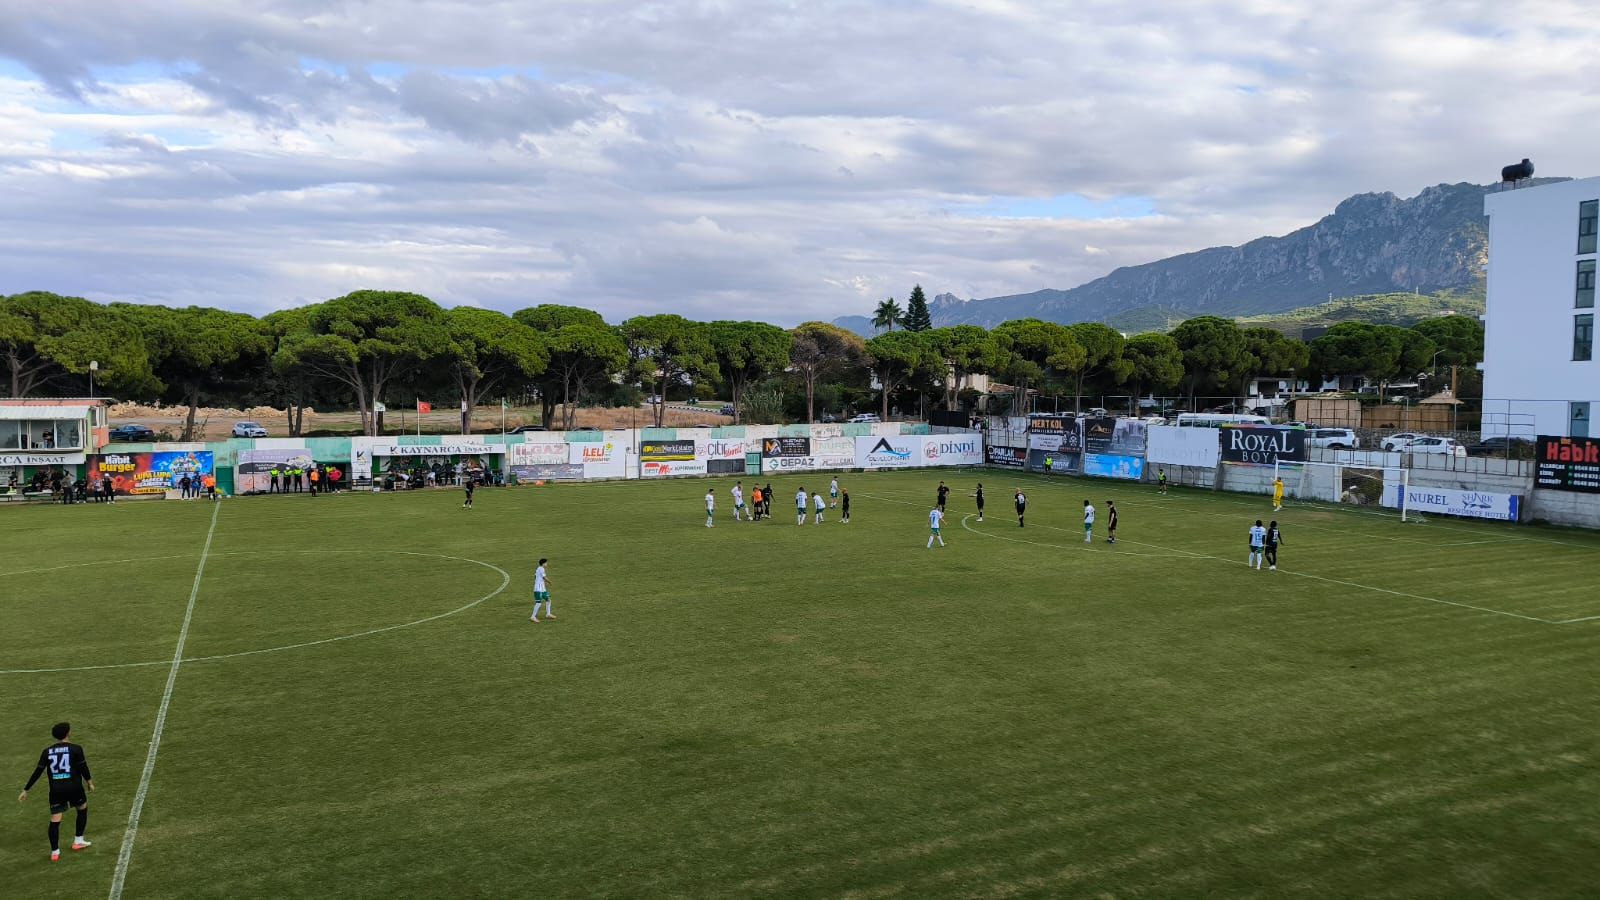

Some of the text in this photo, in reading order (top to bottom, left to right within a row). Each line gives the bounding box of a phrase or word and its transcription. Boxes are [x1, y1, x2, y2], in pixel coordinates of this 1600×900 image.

[1230, 429, 1295, 453] ROYAL
[401, 446, 461, 454] KAYNARCA
[1547, 441, 1599, 463] Habit
[105, 455, 130, 464] Habit
[780, 458, 815, 467] GEPAZ
[1243, 451, 1279, 463] BOYA
[99, 462, 136, 473] Burger
[1410, 492, 1448, 505] NUREL
[1462, 493, 1494, 503] SHARK
[1447, 507, 1508, 519] RESIDENCE HOTEL
[48, 754, 71, 773] 24
